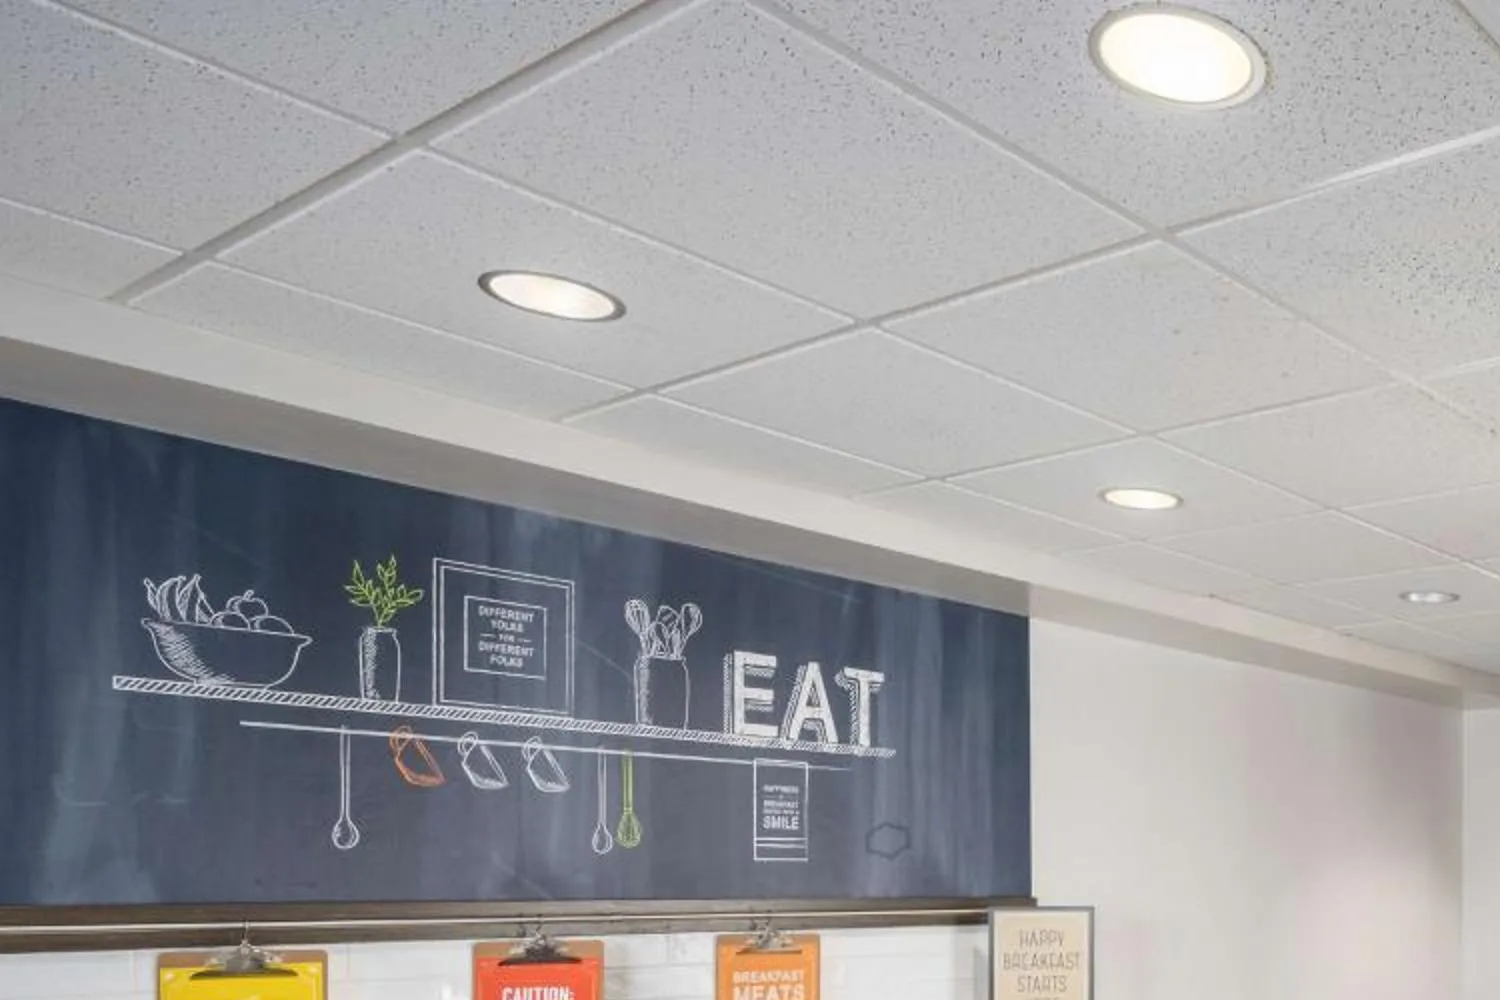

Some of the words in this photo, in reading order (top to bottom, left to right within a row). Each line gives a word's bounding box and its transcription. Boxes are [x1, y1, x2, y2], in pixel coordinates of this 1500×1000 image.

[478, 605, 534, 622] DIFFERENT
[491, 620, 524, 633] YOLKS
[478, 640, 534, 656] DIFFERENT
[490, 654, 523, 667] FOLKS
[723, 649, 885, 748] EAT
[763, 815, 800, 830] SMILE
[1019, 929, 1065, 948] HAPPY
[1003, 952, 1079, 971] BREAKFAST
[733, 969, 805, 983] BREAKFAST
[1017, 975, 1067, 993] STARTS
